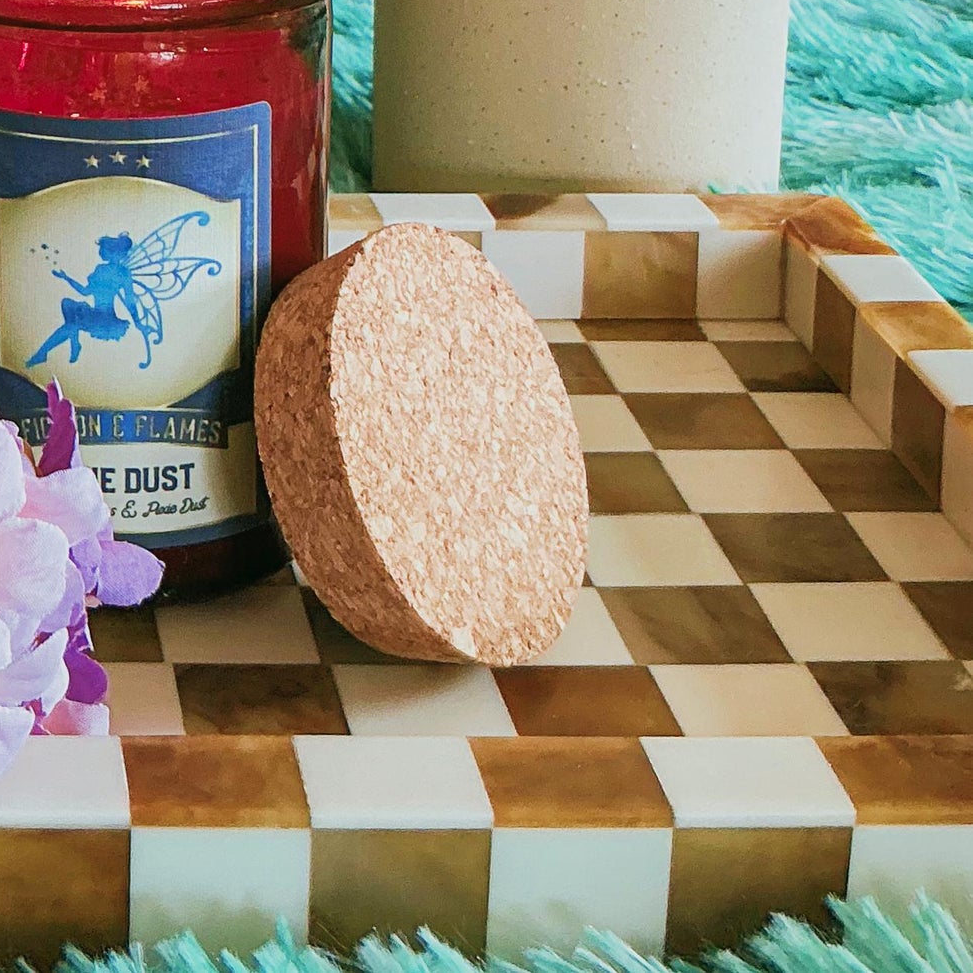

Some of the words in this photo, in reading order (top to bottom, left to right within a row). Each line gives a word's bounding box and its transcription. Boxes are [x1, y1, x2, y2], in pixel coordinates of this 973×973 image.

[20, 413, 101, 441] FICON
[135, 415, 222, 445] FLAMES
[124, 463, 195, 494] DUST
[179, 497, 210, 513] Dust
